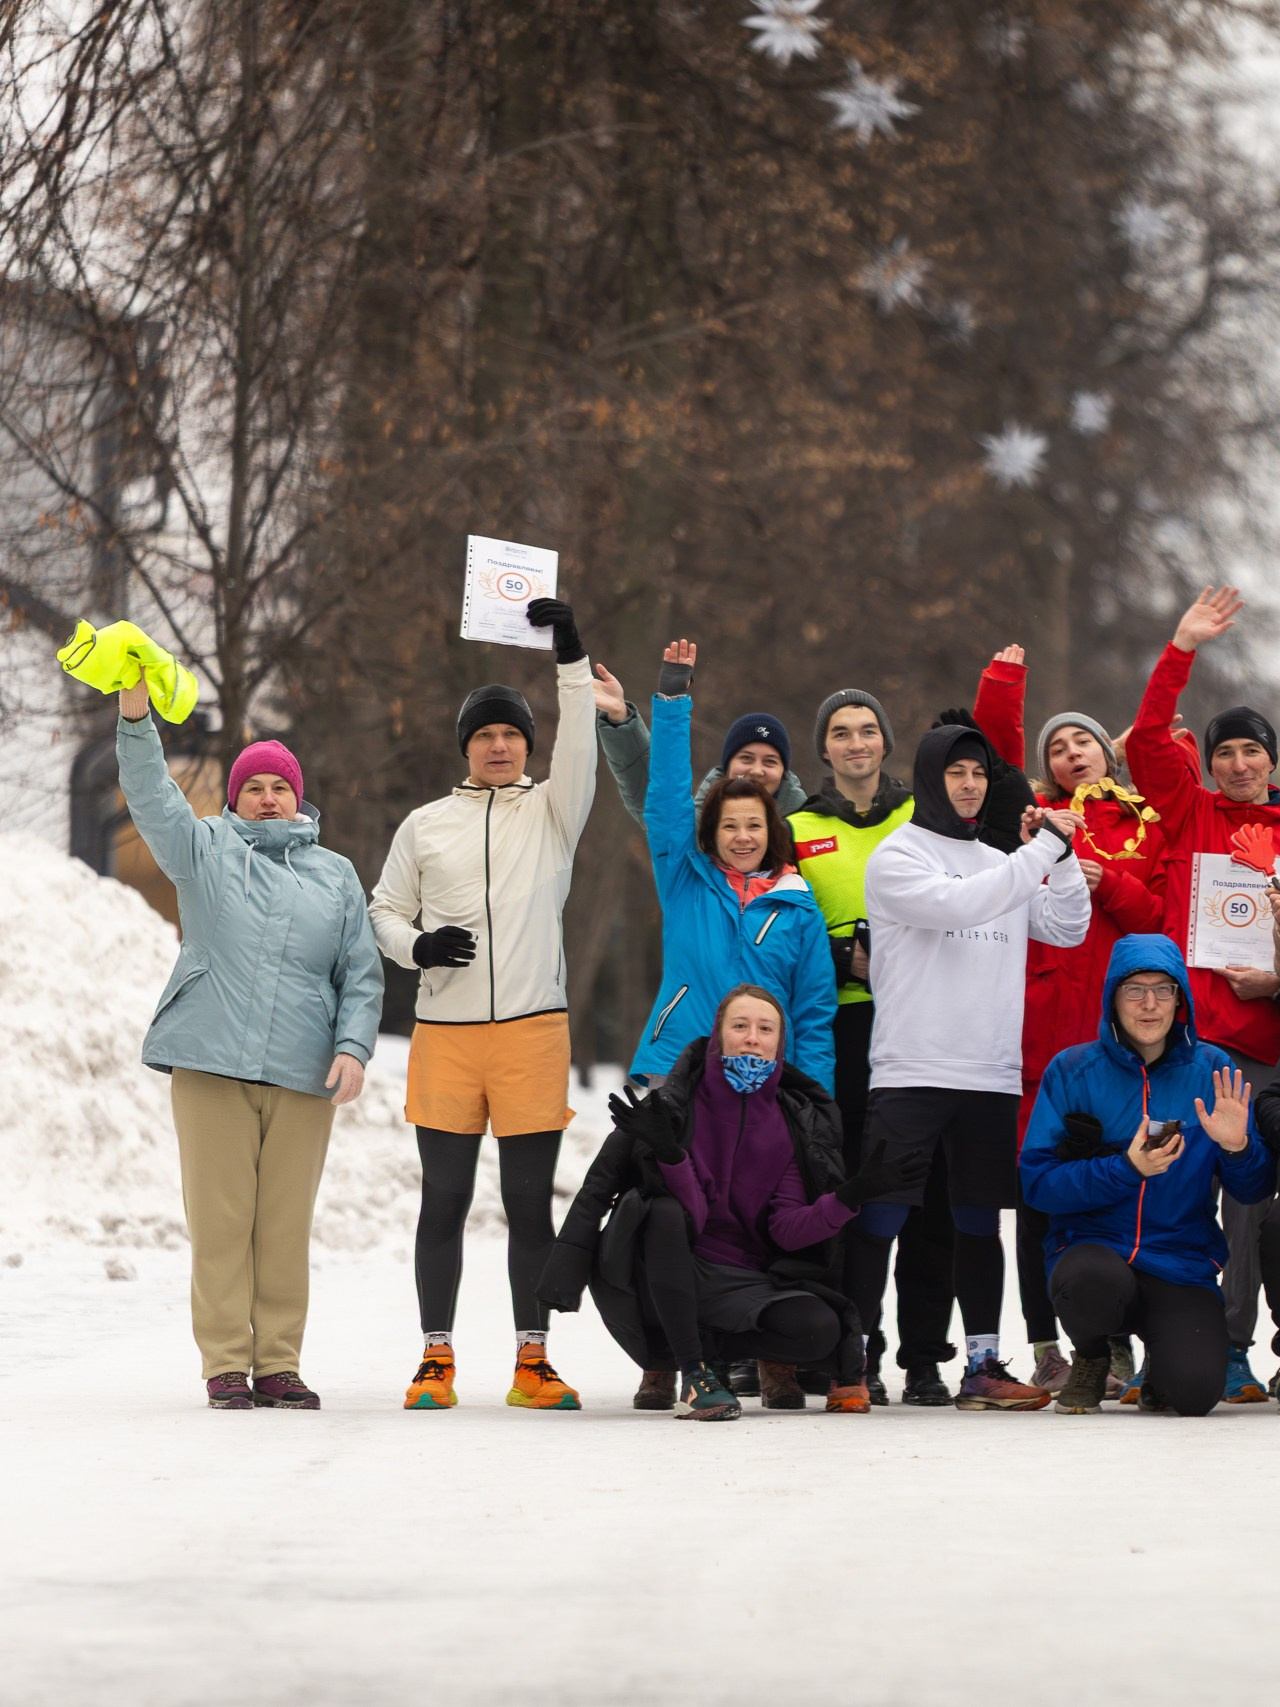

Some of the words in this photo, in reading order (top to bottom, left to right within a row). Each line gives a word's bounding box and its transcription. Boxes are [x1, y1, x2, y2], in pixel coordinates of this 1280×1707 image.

[487, 558, 544, 574] Поздравляем!
[505, 579, 524, 591] 50
[1212, 880, 1269, 889] Поздравляем
[1230, 902, 1248, 914] 50
[946, 929, 1009, 943] HILFIGER
